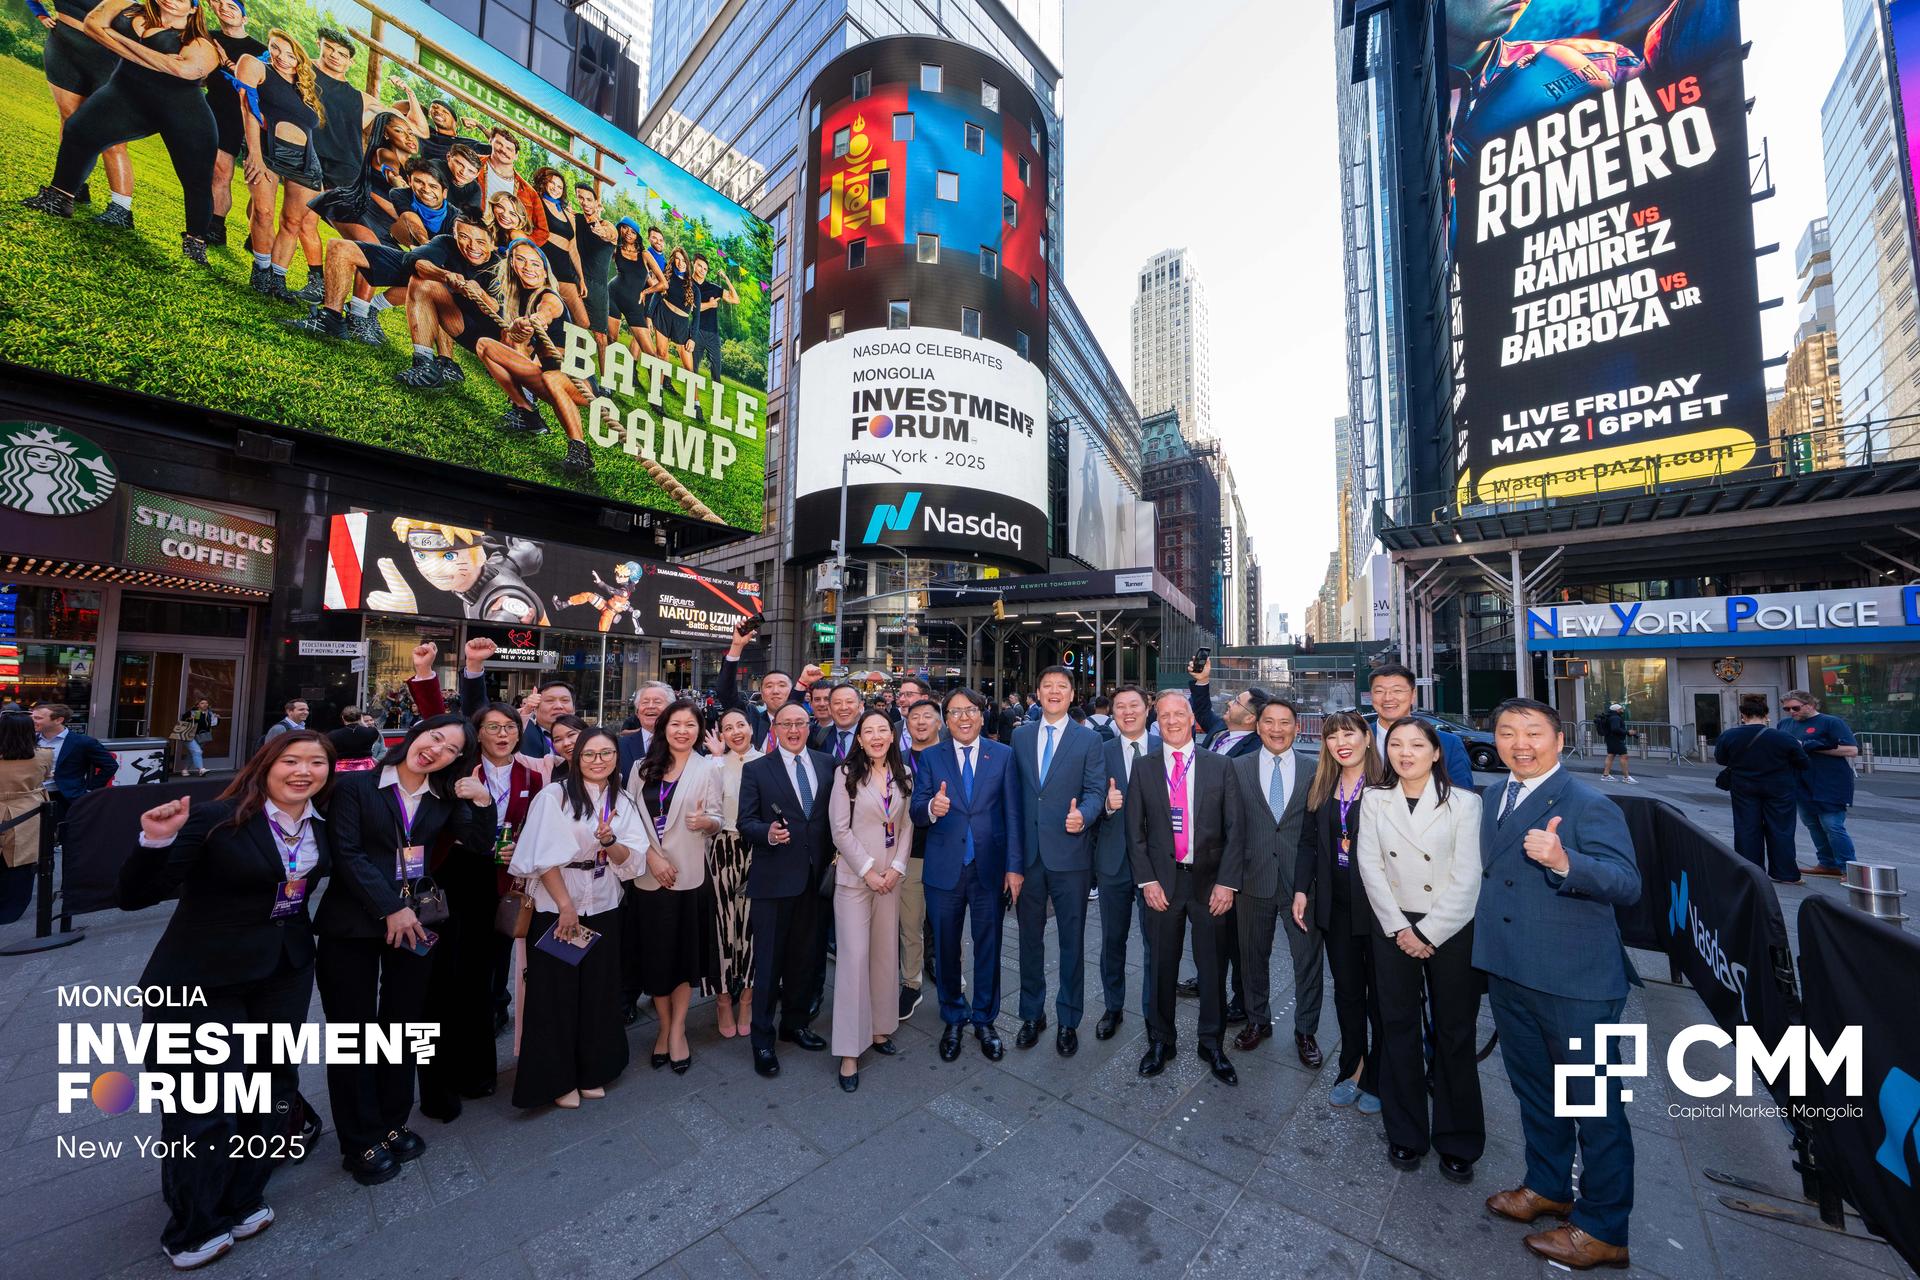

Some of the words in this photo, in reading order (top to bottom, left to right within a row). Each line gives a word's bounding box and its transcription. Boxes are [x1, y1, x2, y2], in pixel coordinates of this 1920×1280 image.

[434, 59, 508, 113] BATTLE
[515, 109, 561, 140] CAMP
[1480, 77, 1658, 186] GARCIA
[1656, 75, 1702, 113] VS
[1477, 105, 1717, 244] ROMERO
[1514, 219, 1676, 297] RAMIREZ
[1523, 202, 1630, 264] HANEY
[1632, 206, 1660, 227] VS
[1512, 268, 1659, 333] TEOFIMO
[1659, 272, 1688, 292] VS
[1501, 296, 1670, 367] BARBOZA
[1670, 286, 1702, 310] JR
[560, 321, 759, 440] BATTLE
[853, 342, 911, 359] NASDAQ
[916, 343, 1003, 370] CELEBRATES
[853, 367, 935, 383] MONGOLIA
[852, 387, 1034, 438] INVESTMENT
[1491, 427, 1555, 456] MAY
[1559, 424, 1581, 444] 2
[1599, 405, 1672, 436] 6PM
[1679, 393, 1729, 421] ET
[1502, 402, 1570, 432] LIVE
[1575, 373, 1702, 417] FRIDAY
[588, 395, 737, 480] CAMP
[852, 414, 969, 442] FORUM
[849, 450, 886, 465] New
[892, 449, 927, 463] York
[945, 452, 986, 470] 2025
[1493, 471, 1558, 493] Watch
[1564, 467, 1587, 482] at
[135, 505, 273, 555] STARBUCKS
[924, 506, 1022, 551] Nasdaq
[1222, 529, 1231, 556] Locker
[161, 537, 248, 571] COFFEE
[1223, 557, 1231, 576] Foot
[659, 605, 706, 622] NARUTO
[536, 650, 556, 658] STORE
